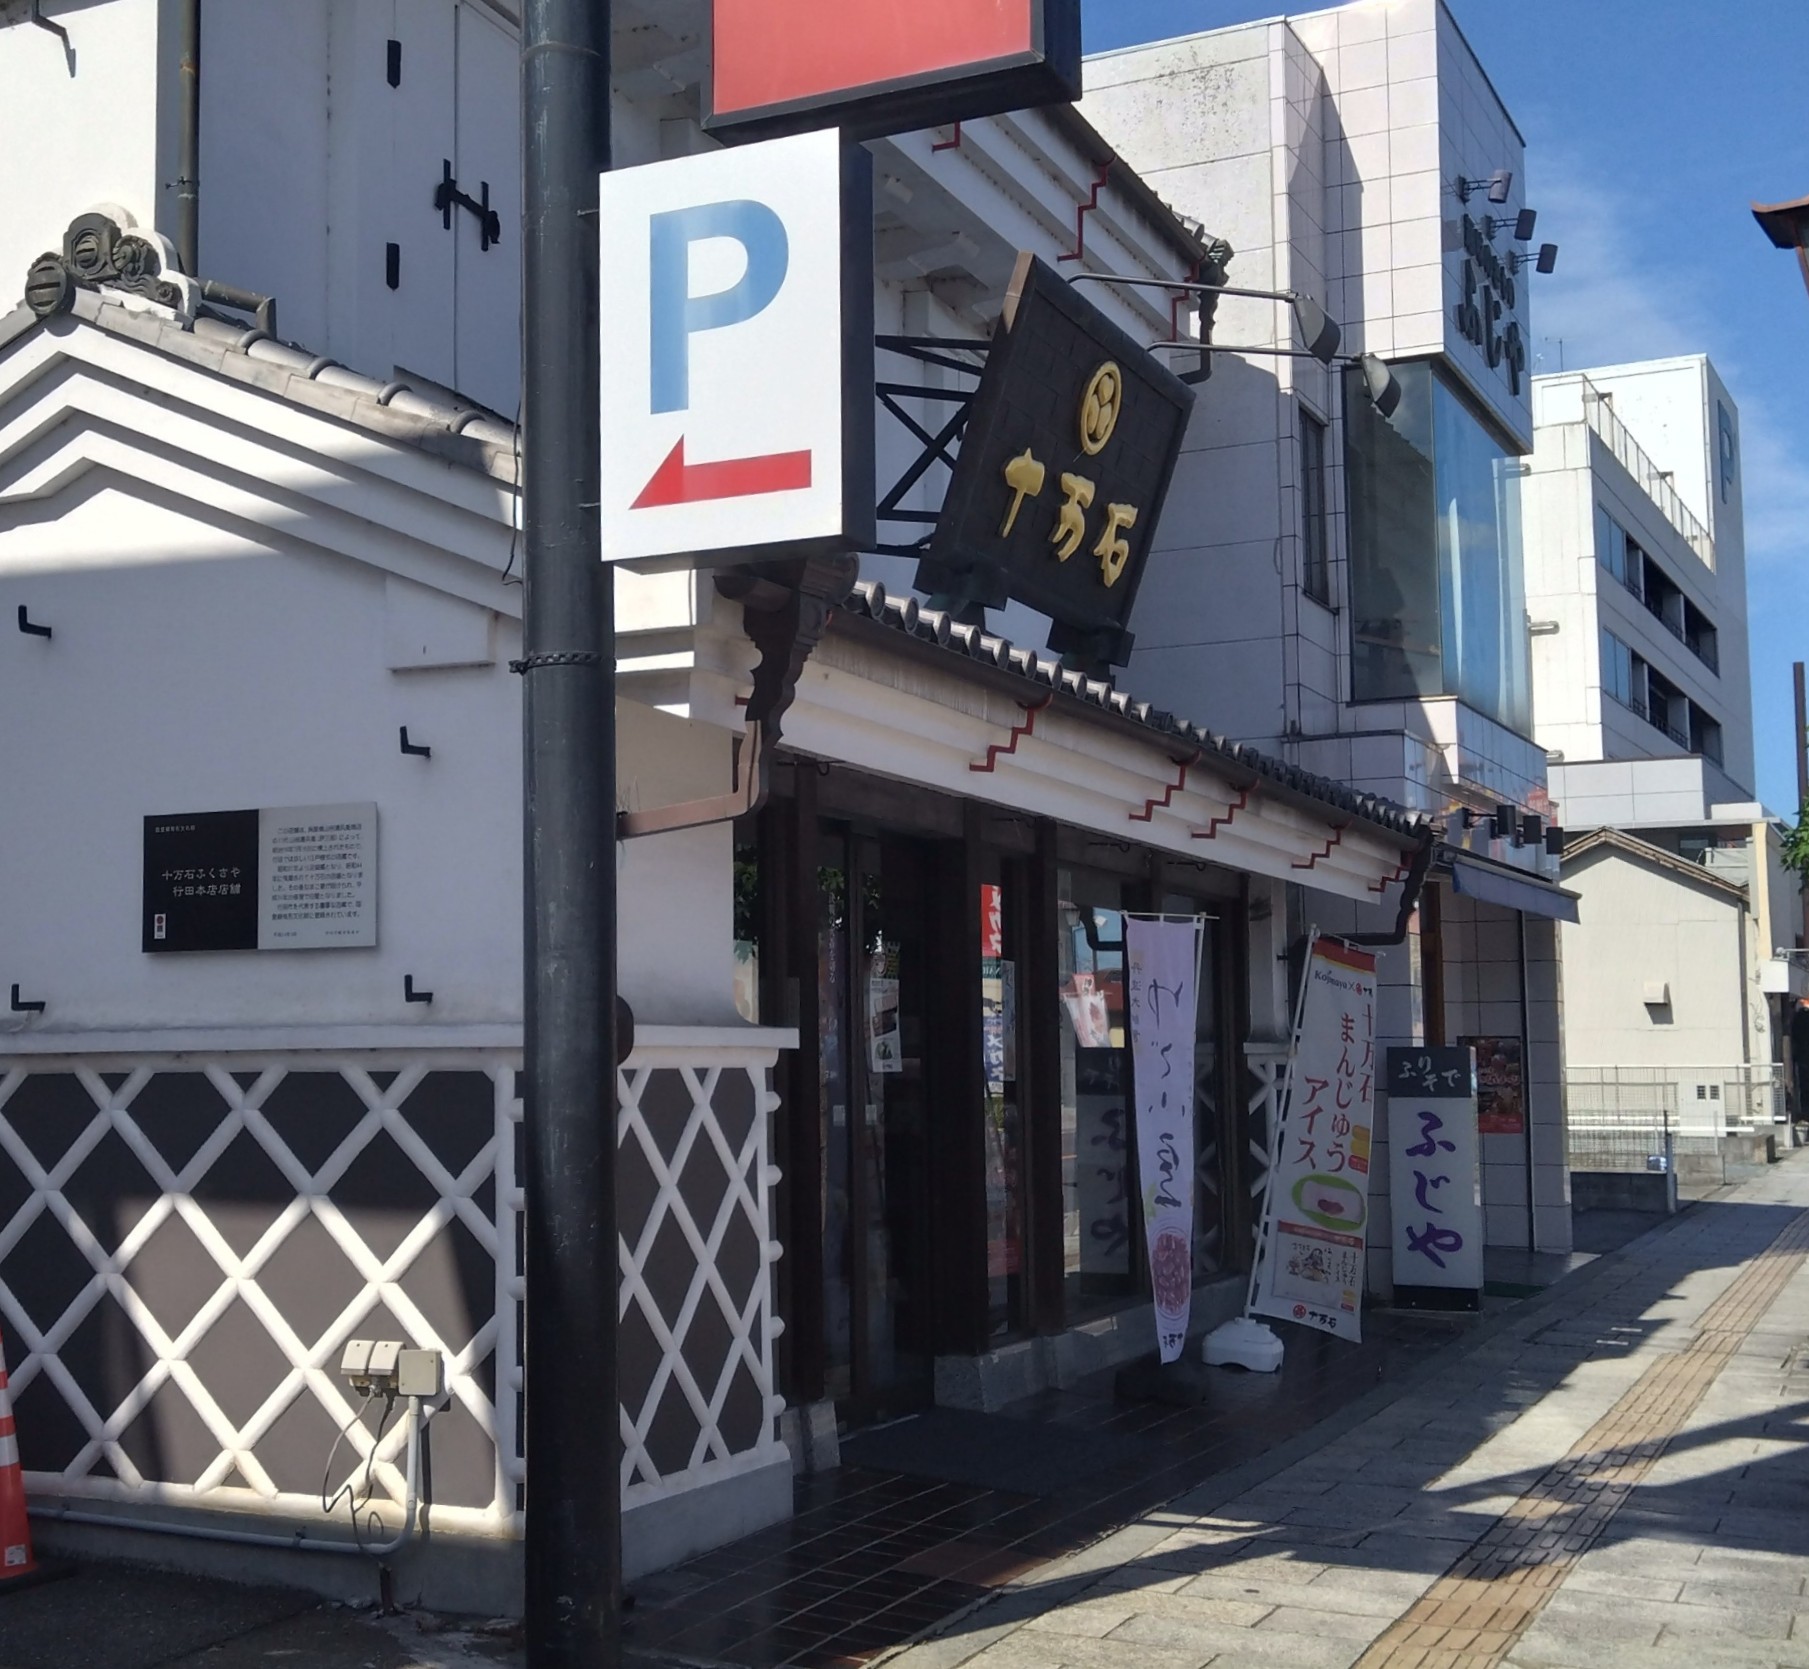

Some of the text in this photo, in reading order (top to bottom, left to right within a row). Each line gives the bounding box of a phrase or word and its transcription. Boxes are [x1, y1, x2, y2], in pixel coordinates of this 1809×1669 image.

[650, 199, 789, 415] P
[1005, 447, 1138, 588] 十万石
[1293, 1076, 1329, 1169] アイス
[1327, 1012, 1355, 1172] まんじゅう
[1398, 1056, 1461, 1092] ふりそで
[1405, 1111, 1463, 1269] ふじや
